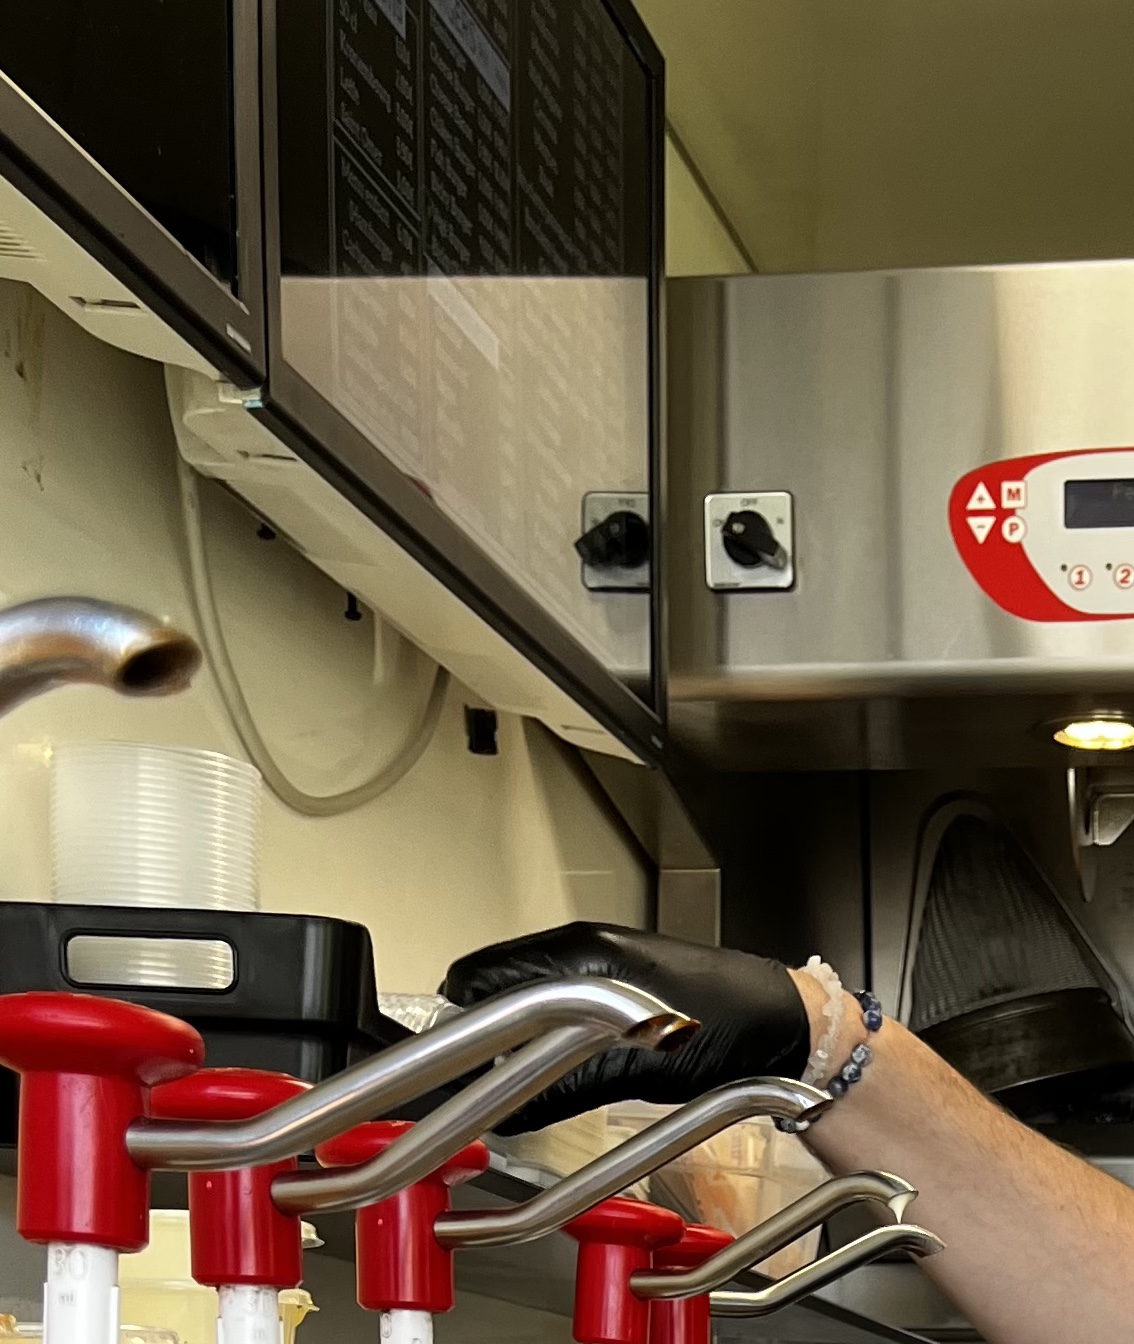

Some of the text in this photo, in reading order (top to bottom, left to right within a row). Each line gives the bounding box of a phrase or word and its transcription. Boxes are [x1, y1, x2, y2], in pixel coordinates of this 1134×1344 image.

[1006, 487, 1022, 502] M
[1008, 521, 1021, 537] P
[1074, 569, 1085, 585] 1
[1119, 568, 1131, 584] 2
